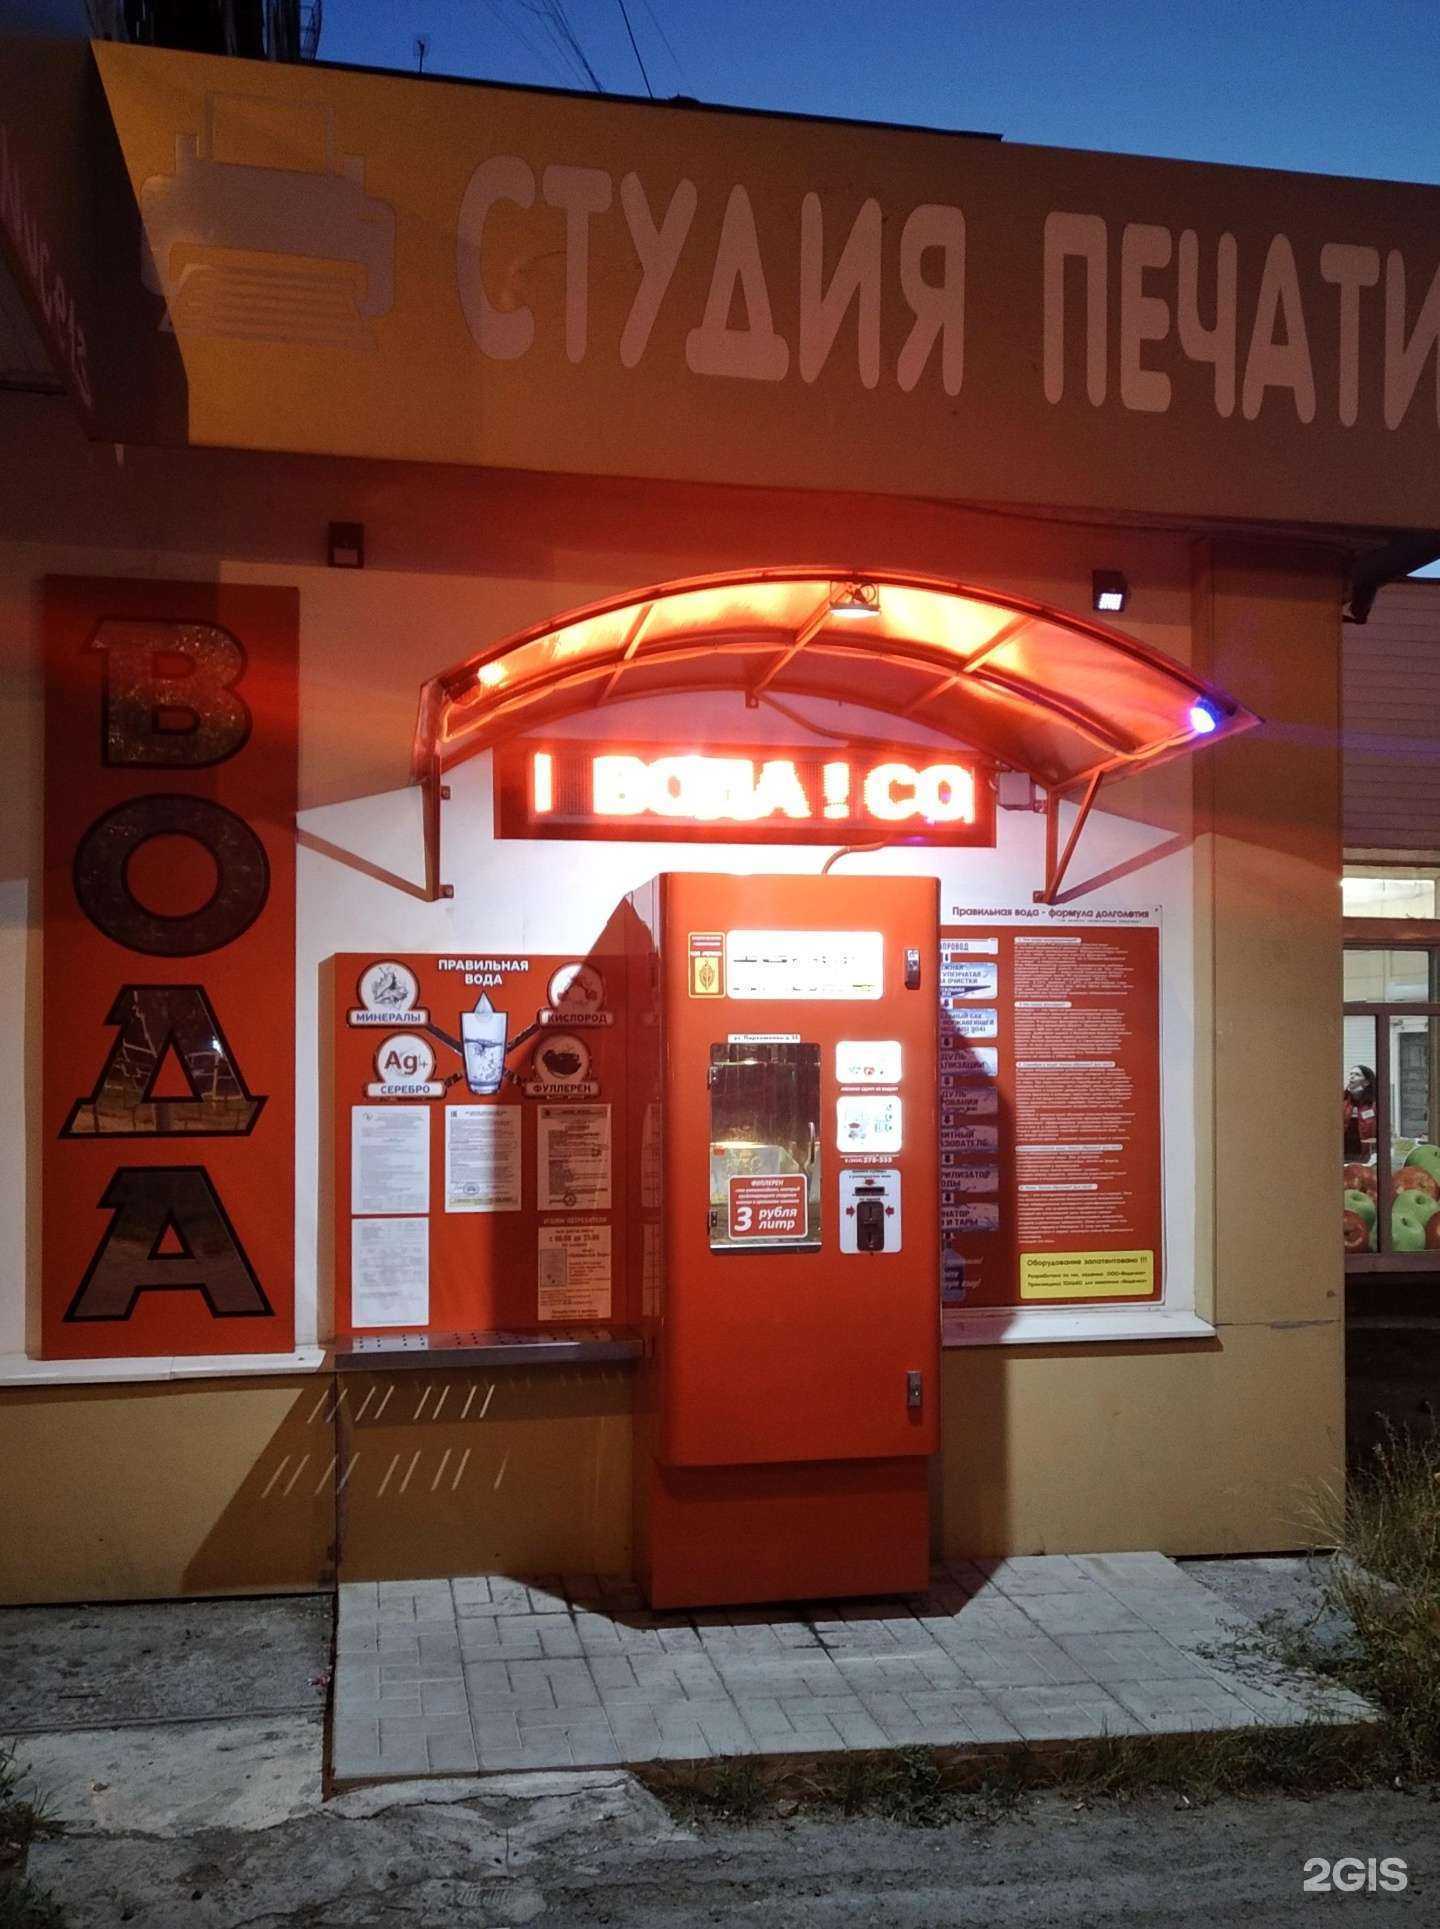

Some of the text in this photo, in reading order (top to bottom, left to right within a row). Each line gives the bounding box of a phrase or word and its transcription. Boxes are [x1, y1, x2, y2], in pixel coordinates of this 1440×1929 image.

[456, 155, 1440, 432] СТУДИЯ ПЕЧАТИ
[953, 906, 1012, 917] Правильная
[1014, 908, 1039, 918] вода
[1048, 907, 1093, 919] формула
[1095, 910, 1149, 919] долголетия
[57, 618, 276, 1324] ВОДА
[438, 959, 529, 972] ПРАВИЛЬНАЯ
[465, 974, 503, 986] ВОДА
[356, 1012, 422, 1023] МИНЕРАЛЫ
[548, 1012, 608, 1024] КИСЛОРОД
[380, 1084, 431, 1095] СЕРЕБРО
[532, 1083, 592, 1095] ФУЛЛЕРЕН
[758, 1206, 798, 1220] рубля
[734, 1207, 753, 1232] 3
[758, 1219, 796, 1231] литр
